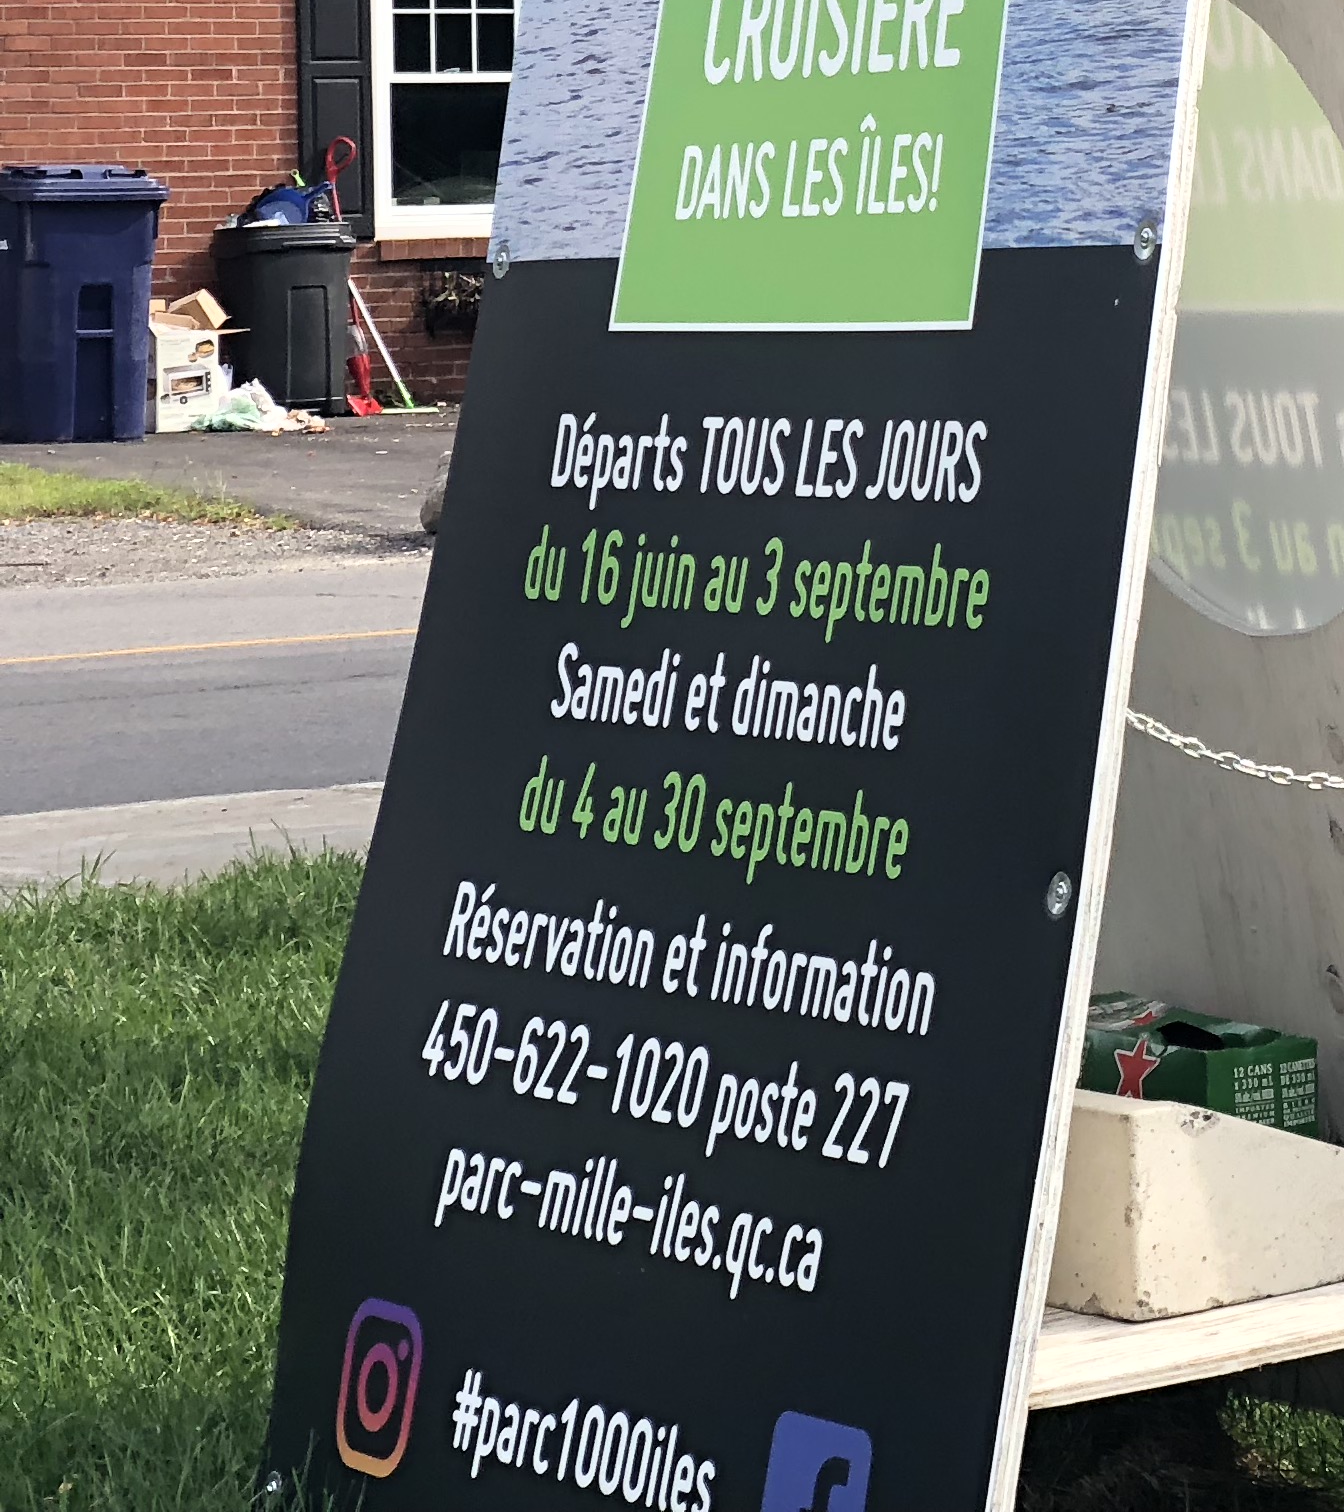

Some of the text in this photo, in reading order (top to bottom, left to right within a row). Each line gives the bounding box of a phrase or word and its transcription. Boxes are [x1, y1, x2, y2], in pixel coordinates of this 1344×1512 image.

[675, 113, 944, 220] DANS LES ÎLES!
[550, 412, 988, 511] Départs TOUS LES JOURS
[524, 524, 990, 644] du 16 juin au 3 septembre
[550, 642, 906, 751] Samedi et dimanche
[518, 754, 909, 885] du 4 au 30 septembre
[443, 880, 936, 1036] Réservation et information
[421, 999, 911, 1170] 450-622-1020 poste 227
[1233, 1063, 1273, 1078] 12 CANS
[434, 1147, 824, 1300] parc-mille-iles.qc.ca
[452, 1368, 717, 1512] #parc1000iles
